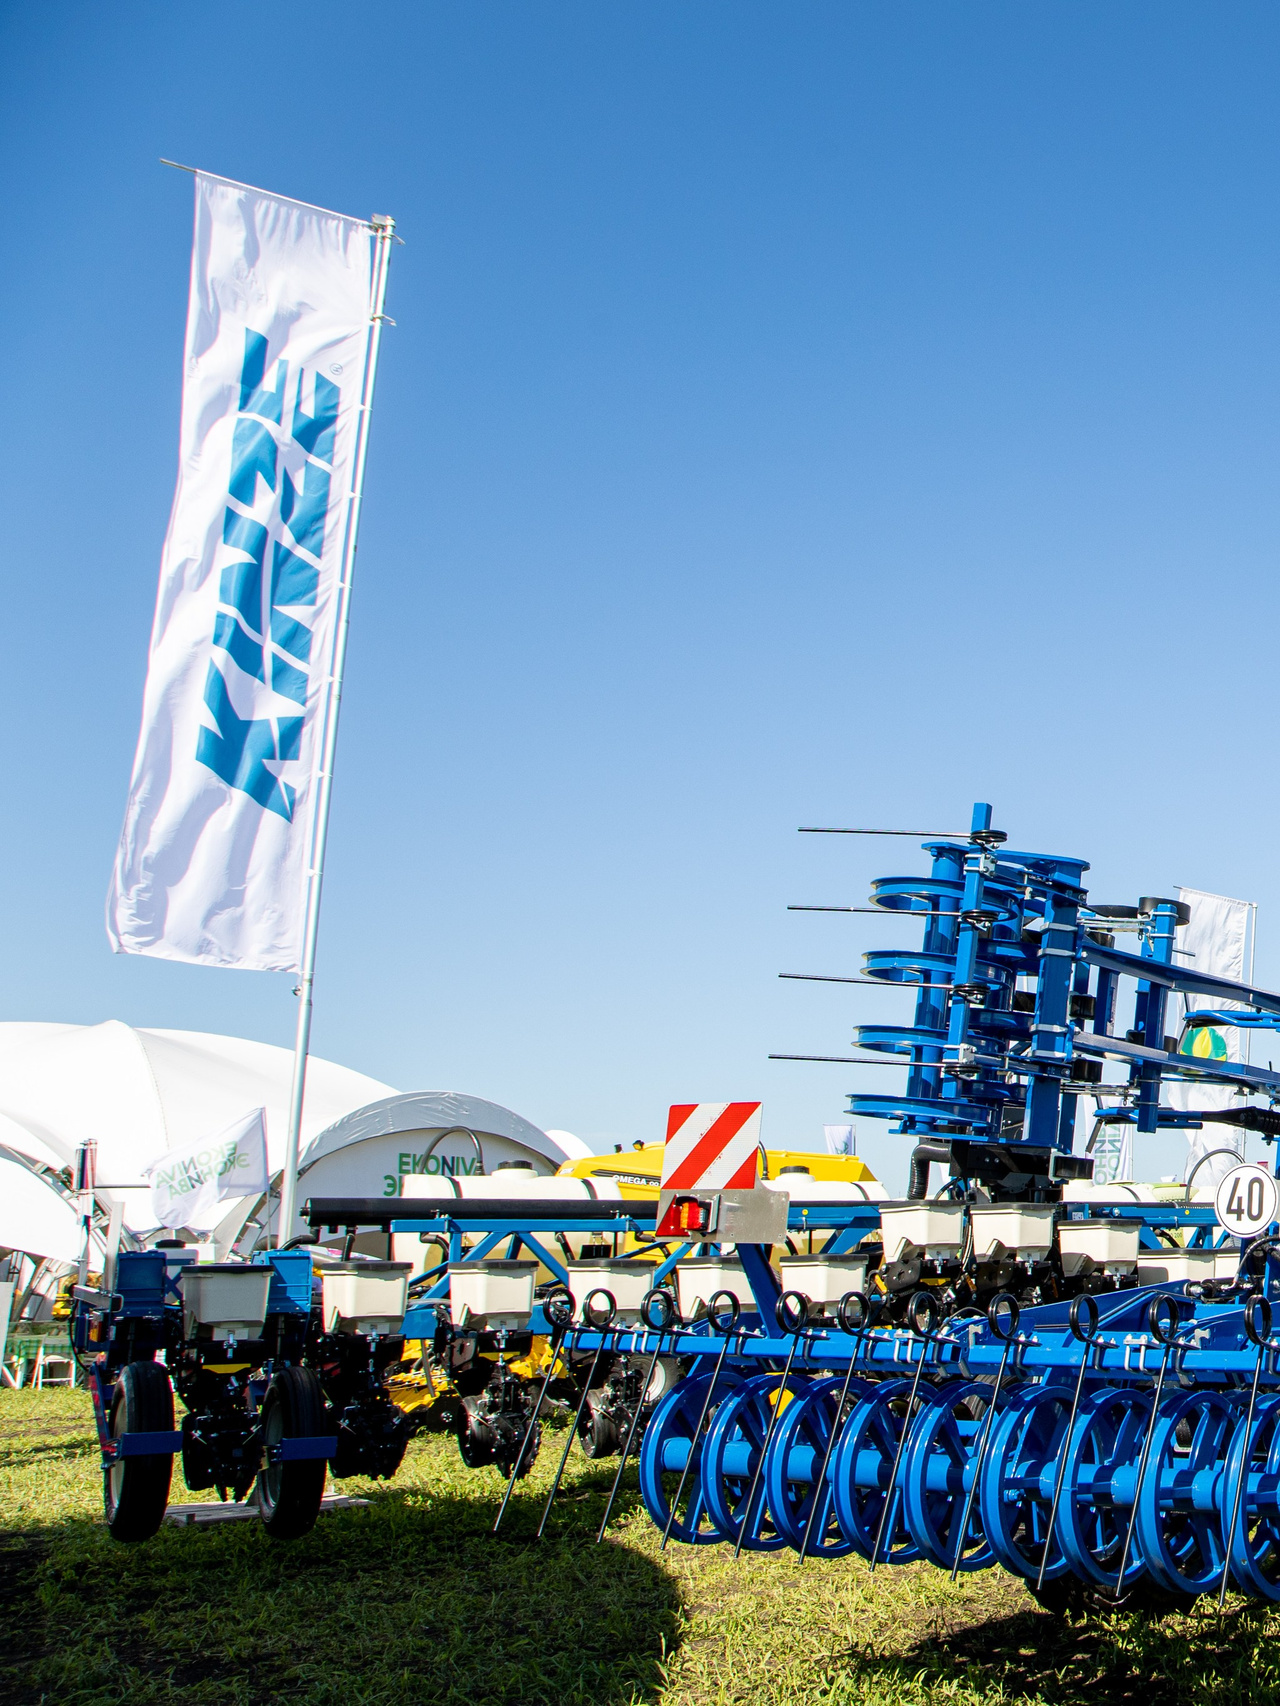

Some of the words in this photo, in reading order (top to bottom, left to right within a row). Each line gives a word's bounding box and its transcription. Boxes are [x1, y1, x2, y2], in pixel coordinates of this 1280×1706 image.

[195, 328, 341, 824] KINZE
[398, 1152, 480, 1176] EKONIV
[612, 1174, 648, 1186] OMEGA
[1226, 1176, 1265, 1222] 40
